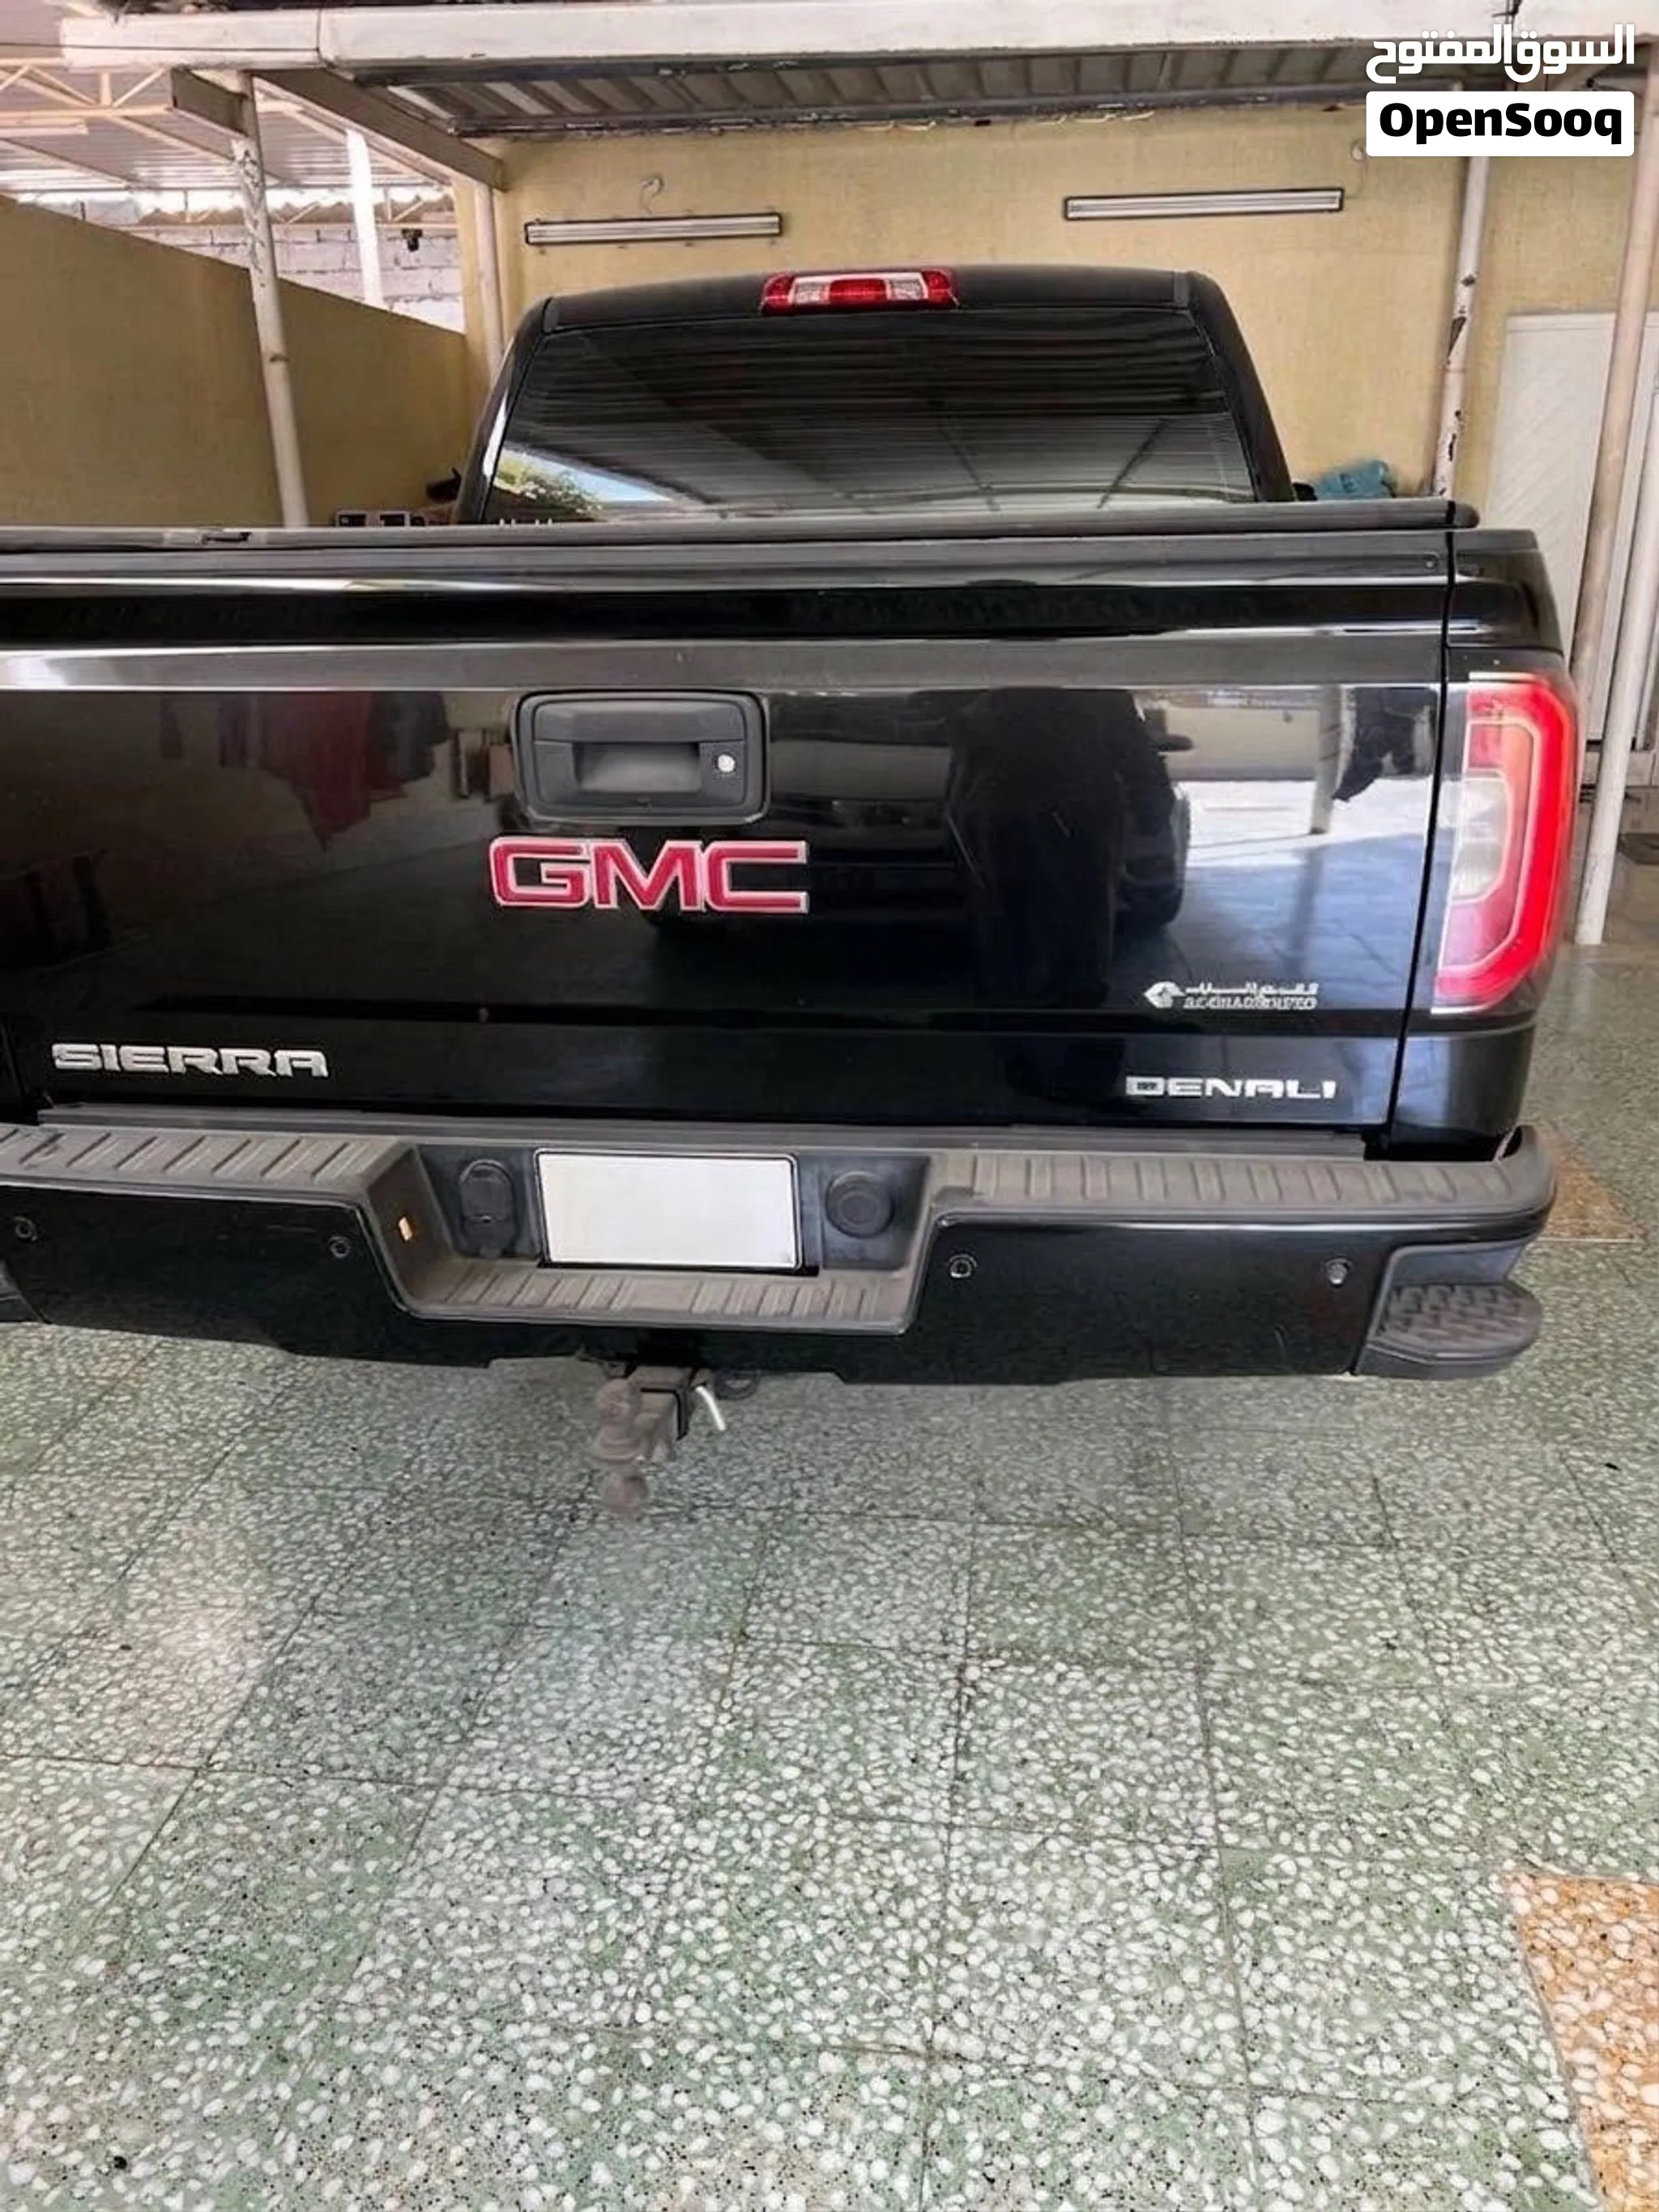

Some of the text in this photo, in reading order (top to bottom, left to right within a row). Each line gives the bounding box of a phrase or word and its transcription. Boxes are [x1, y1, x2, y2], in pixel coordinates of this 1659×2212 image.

[488, 836, 808, 914] GMC
[52, 1043, 328, 1077] SIERRA
[1125, 1076, 1337, 1099] DENALI
